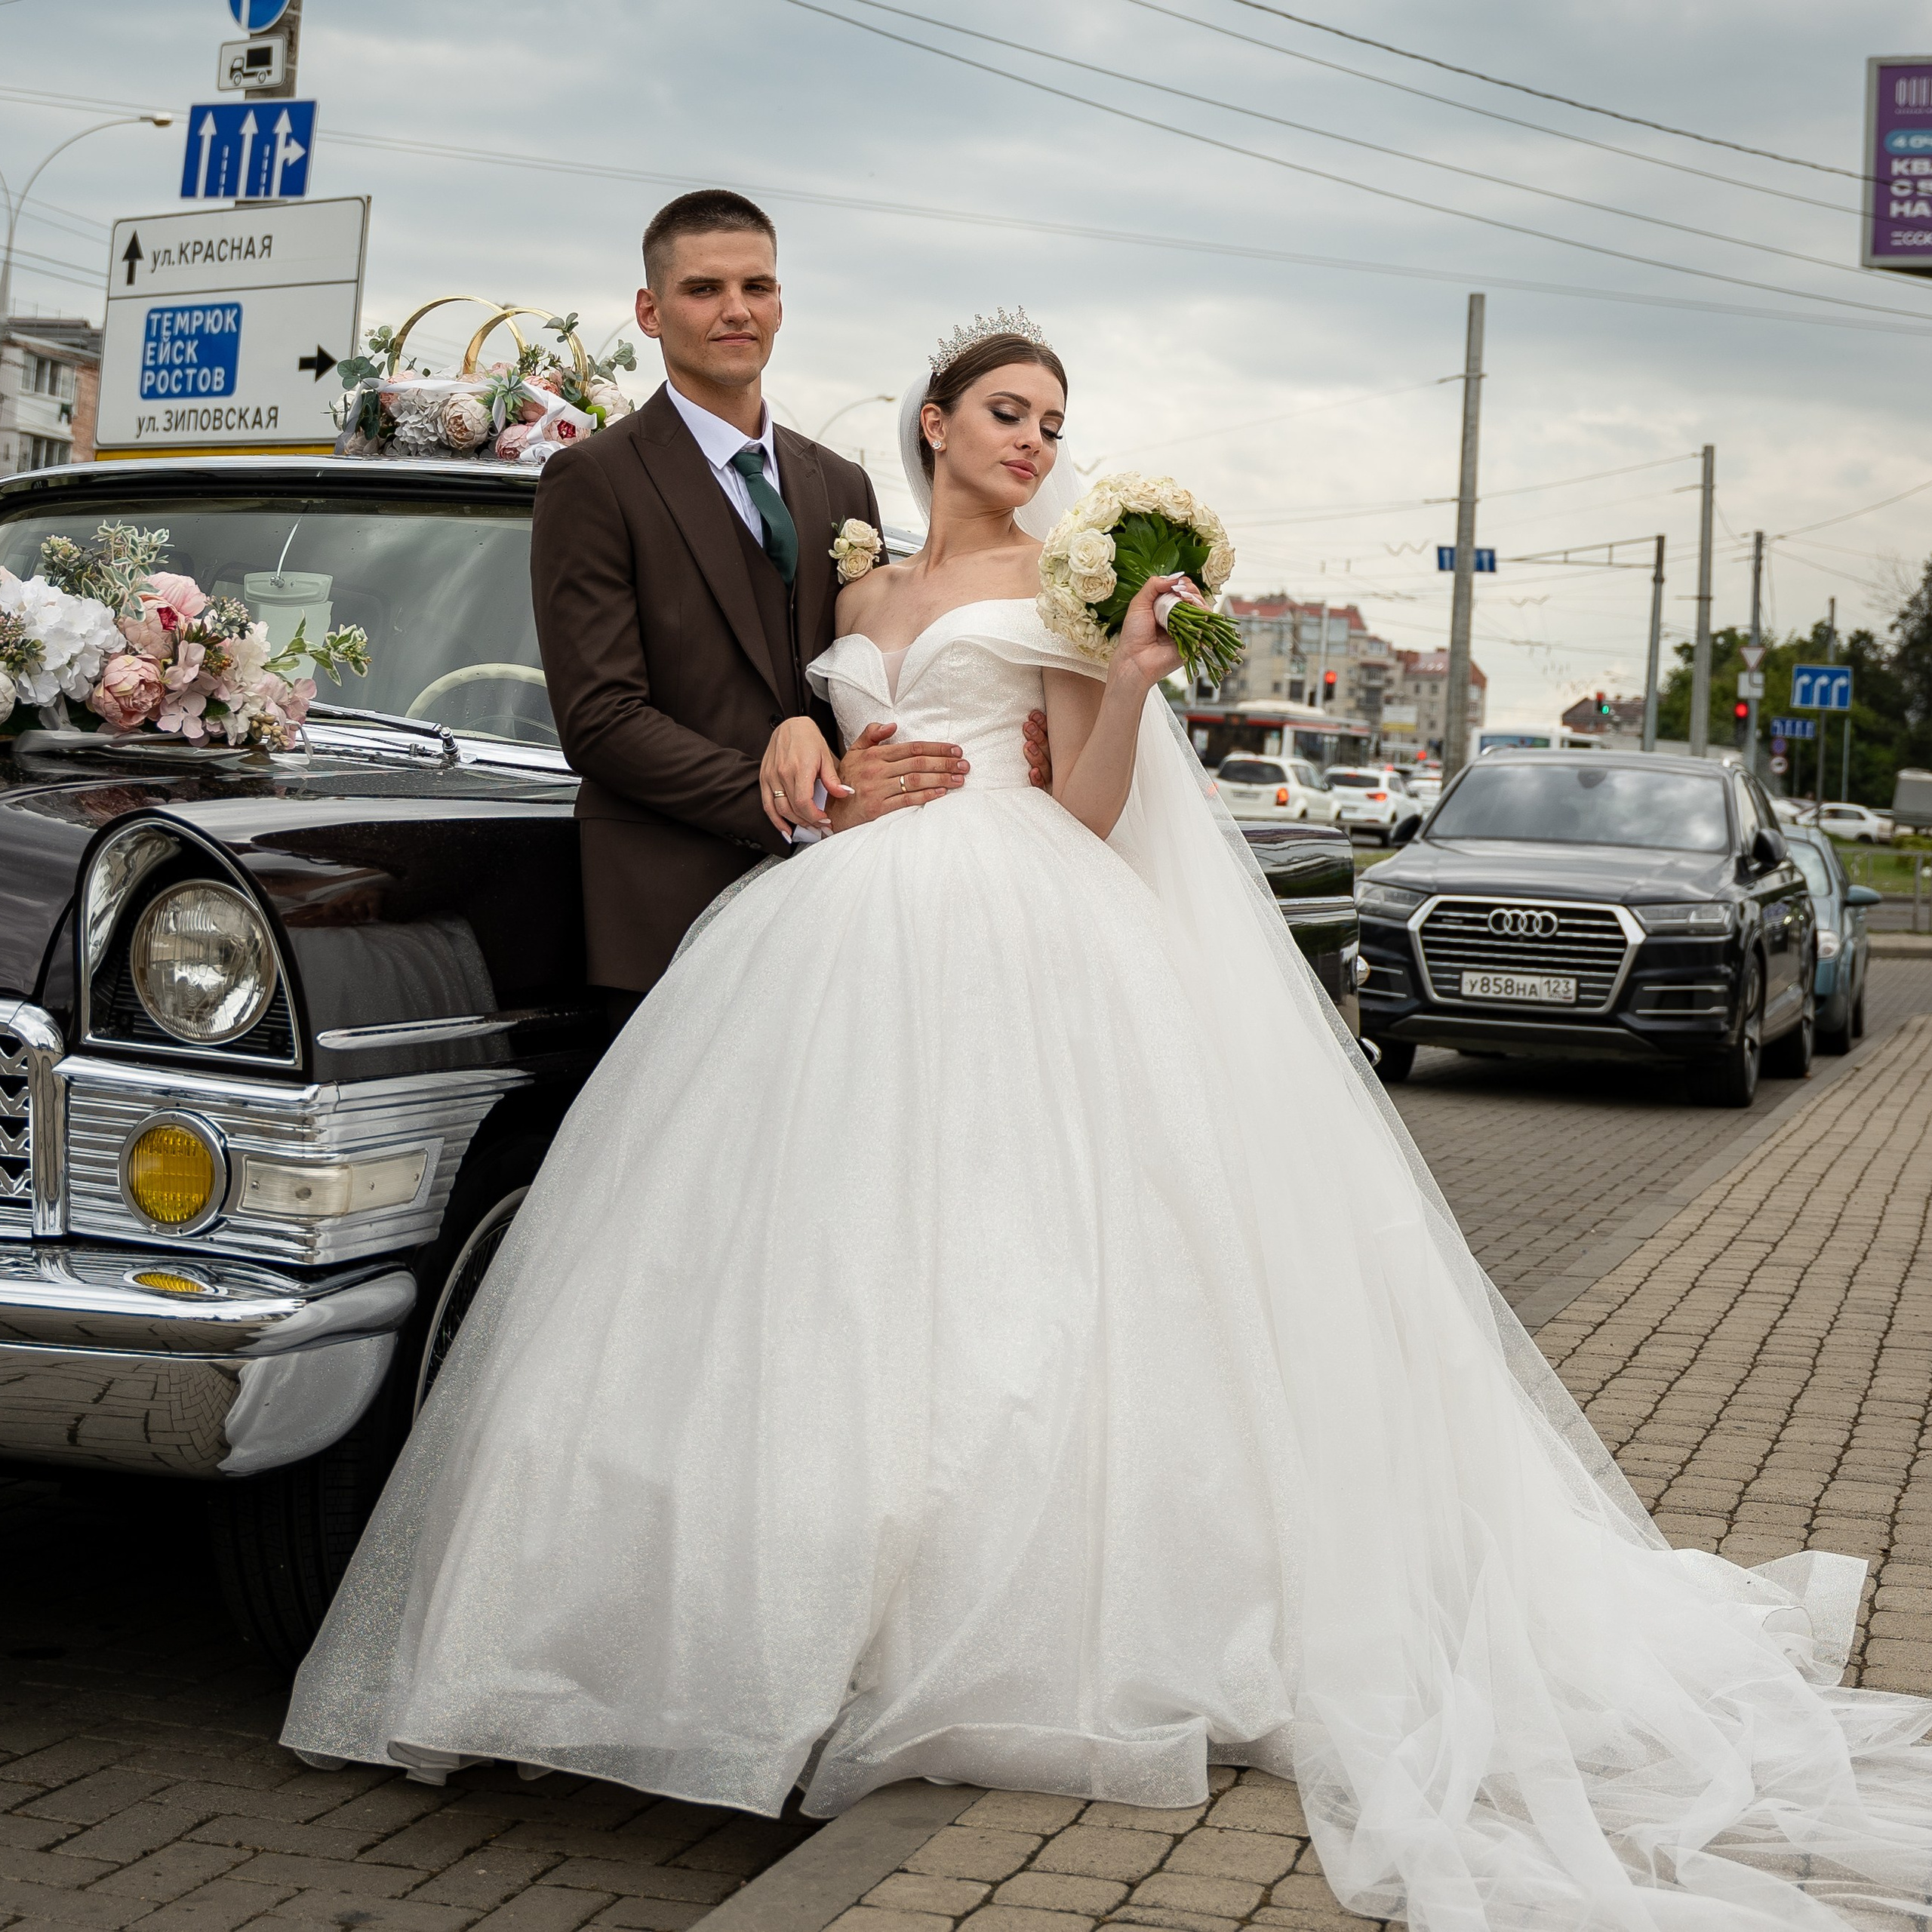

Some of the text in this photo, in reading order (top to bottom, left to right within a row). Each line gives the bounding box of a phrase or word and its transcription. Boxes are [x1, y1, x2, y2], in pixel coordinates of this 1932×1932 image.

[149, 307, 238, 337] ТЕМРЮК
[144, 335, 199, 367] ЕЙСК
[142, 366, 226, 395] РОСТОВ
[1544, 979, 1573, 994] 123
